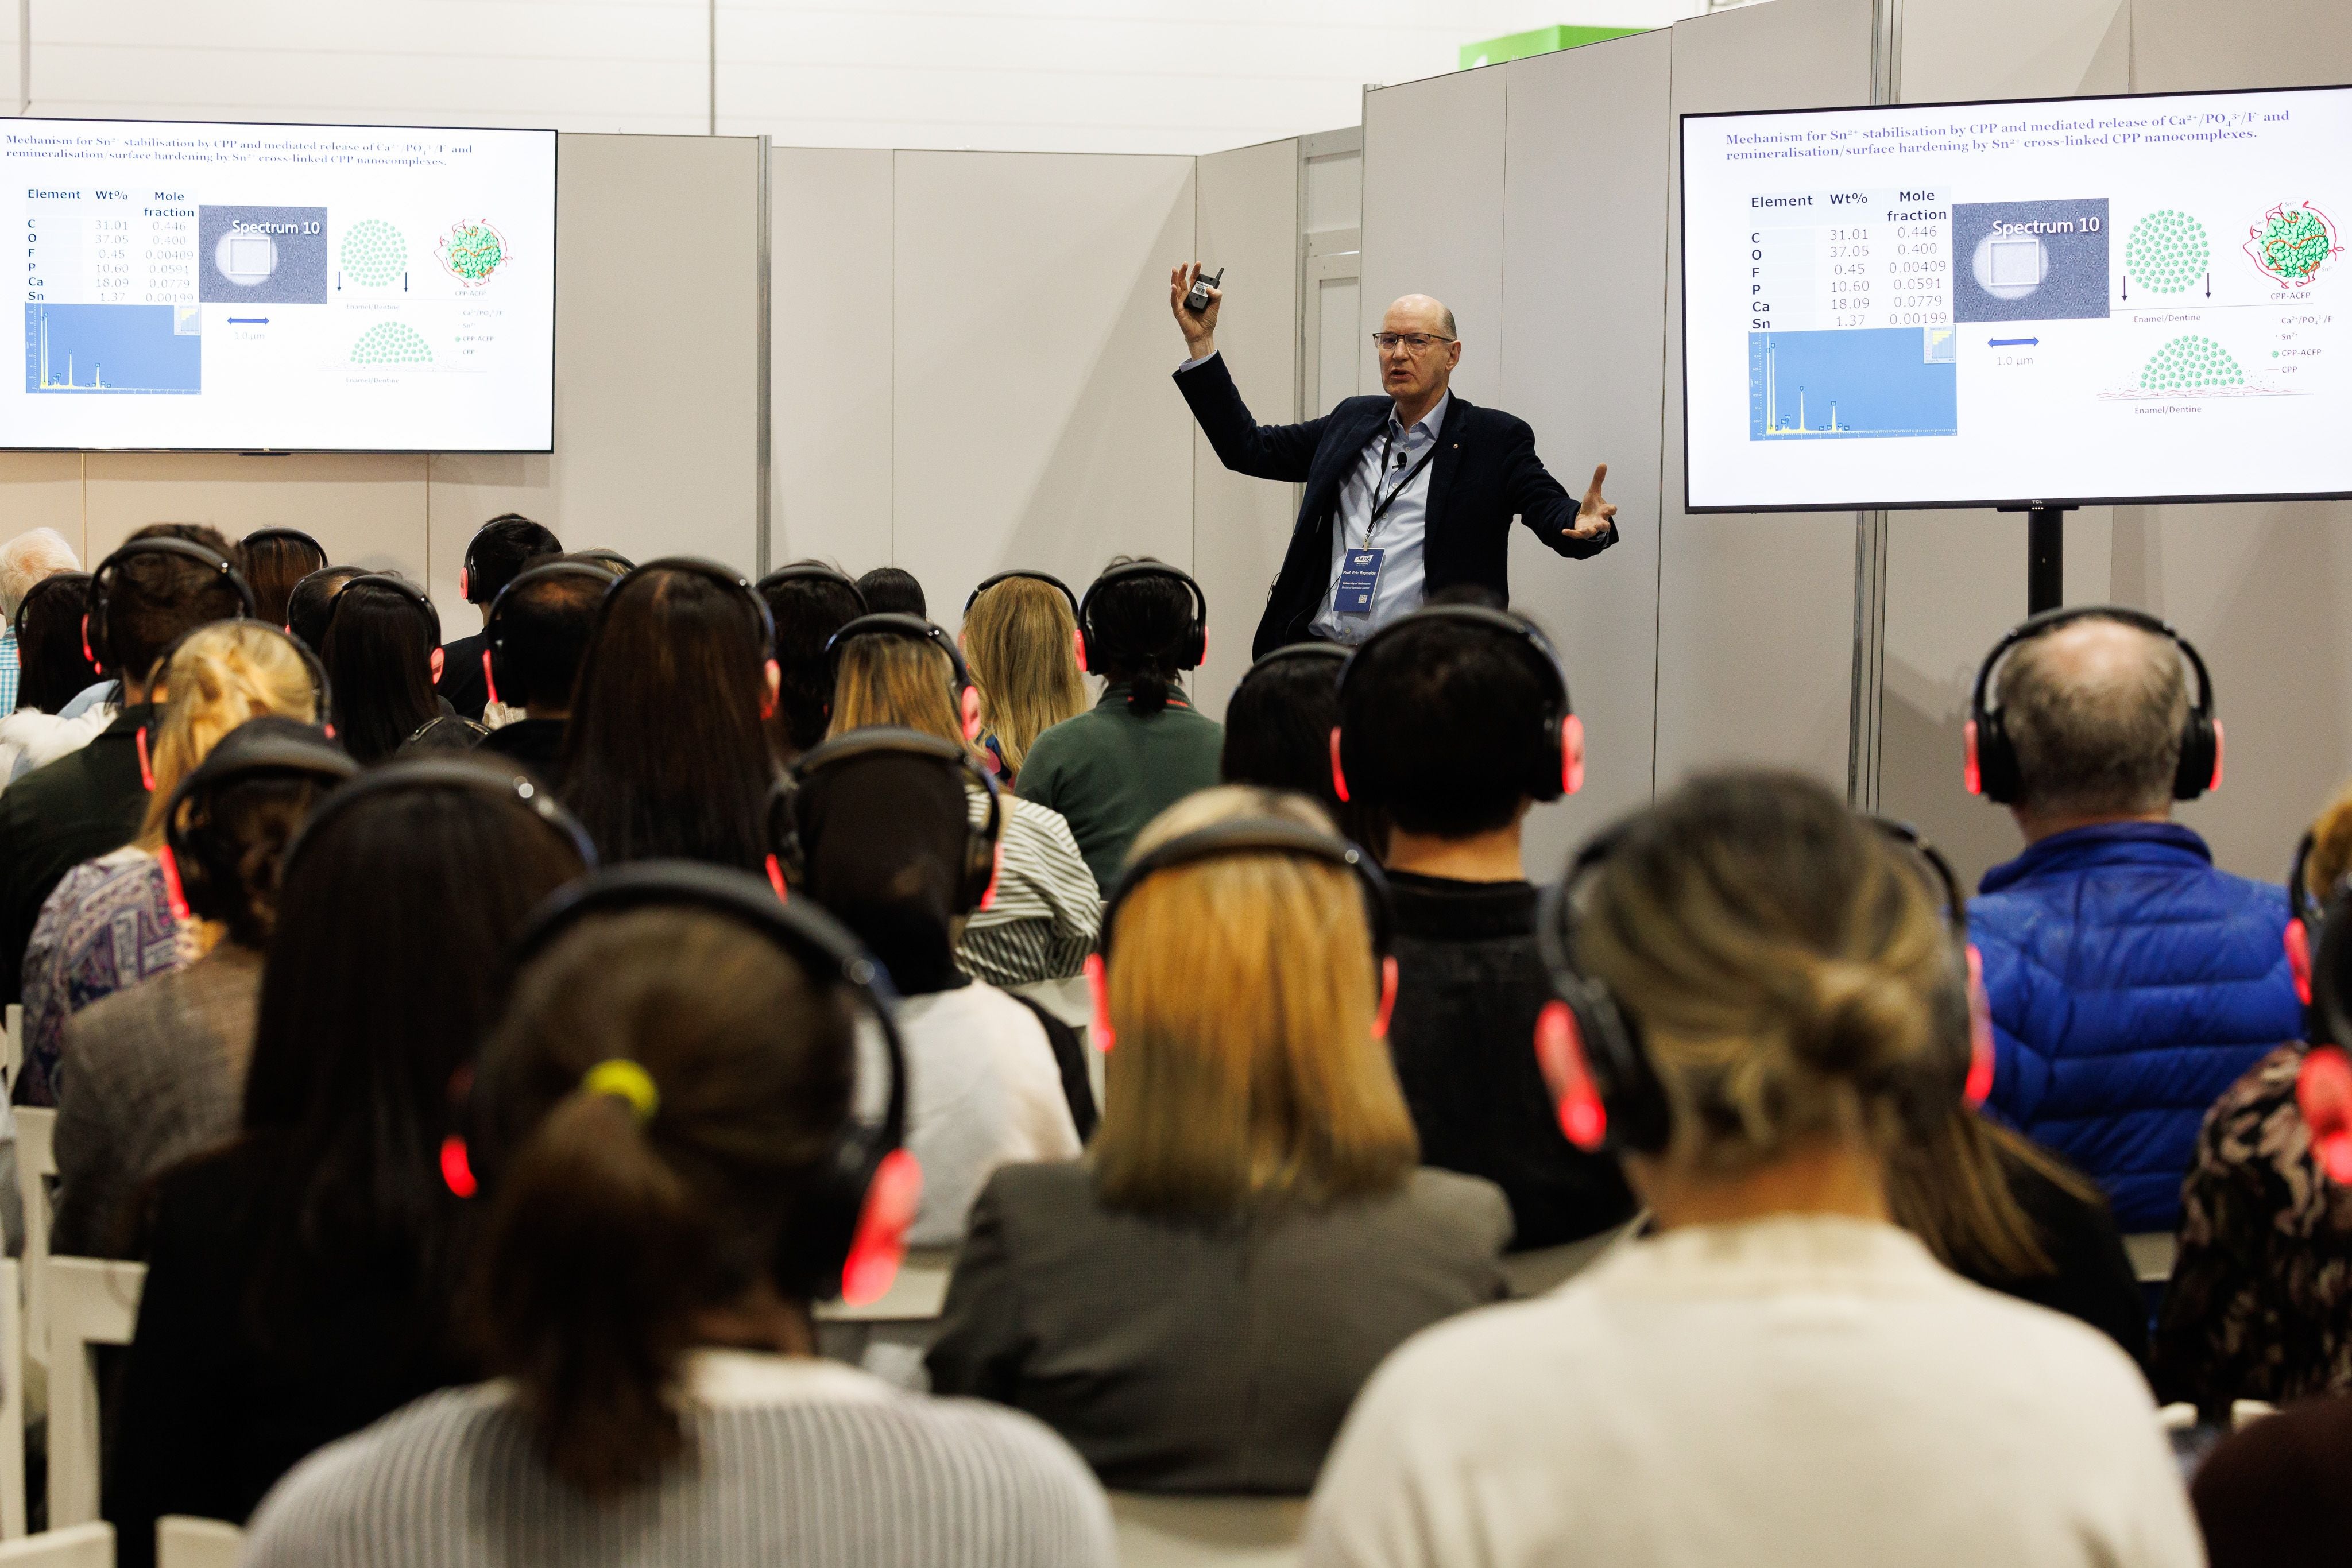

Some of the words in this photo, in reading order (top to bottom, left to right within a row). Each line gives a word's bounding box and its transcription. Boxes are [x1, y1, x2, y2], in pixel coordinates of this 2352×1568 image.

[1726, 132, 1802, 145] Mechanism
[1807, 130, 1827, 141] for
[1862, 124, 1946, 140] stabilisation
[1950, 124, 1966, 137] by
[1970, 123, 1997, 134] CPP
[2001, 121, 2025, 133] and
[2030, 117, 2094, 131] mediated
[2098, 116, 2147, 129] release
[2152, 115, 2166, 126] of
[2264, 110, 2289, 121] and
[6, 135, 72, 144] Mechanism
[76, 136, 93, 145] for
[124, 137, 194, 147] stabilisation
[198, 139, 209, 150] by
[214, 140, 237, 148] CPP
[265, 141, 316, 149] mediated
[363, 143, 375, 151] of
[1726, 144, 1895, 161] remineralisation/surface
[1899, 141, 1969, 155] hardening
[1972, 140, 1987, 153] by
[2024, 134, 2108, 148] cross-linked
[2113, 133, 2140, 144] CPP
[2144, 129, 2257, 145] nanocomplexes.
[6, 148, 150, 160] remineralisation/surface
[154, 152, 213, 162] hardening
[216, 153, 229, 162] by
[259, 154, 327, 163] cross-linked
[331, 156, 354, 164] CPP
[357, 157, 446, 167] nanocomplexes.
[28, 189, 81, 199] Element
[95, 191, 127, 200] Wt%
[154, 192, 184, 201] Mole
[1751, 195, 1813, 208] Element
[1830, 193, 1868, 205] Wt%
[1900, 190, 1935, 202] Mole
[144, 207, 194, 217] fraction
[1887, 210, 1947, 222] fraction
[28, 219, 36, 228] C
[95, 220, 128, 230] 31.01
[153, 221, 186, 231] 0.446
[232, 220, 299, 235] Spectrum
[303, 222, 320, 234] 10
[1993, 219, 2074, 238] Spectrum
[2079, 216, 2099, 233] 10
[28, 234, 36, 243] O
[95, 234, 129, 244] 37.05
[153, 235, 186, 245] 0.400
[1751, 233, 1760, 243] C
[1829, 229, 1869, 241] 31.01
[1898, 226, 1937, 238] 0.446
[29, 249, 35, 257] F
[99, 249, 125, 259] 0.45
[146, 250, 194, 260] 0.00409
[1751, 250, 1762, 261] O
[1830, 246, 1869, 258] 37.05
[1898, 243, 1937, 255] 0.400
[29, 263, 36, 272] P
[96, 264, 129, 273] 10.60
[149, 265, 189, 274] 0.0591
[1753, 268, 1759, 278] F
[1835, 264, 1865, 275] 0.45
[1889, 261, 1947, 273] 0.00409
[28, 278, 44, 287] Ca
[96, 278, 129, 288] 18.09
[149, 279, 190, 288] 0.0779
[1753, 285, 1761, 295] P
[1832, 281, 1869, 292] 10.60
[1894, 278, 1941, 291] 0.0591
[28, 292, 44, 300] Sn
[100, 292, 125, 301] 1.37
[146, 293, 194, 302] 0.00199
[1752, 301, 1770, 312] Ca
[1832, 298, 1869, 310] 18.09
[1894, 295, 1942, 308] 0.0779
[1752, 318, 1771, 329] Sn
[1836, 315, 1866, 327] 1.37
[1890, 312, 1947, 326] 0.00199
[2133, 313, 2201, 323] Enamel/Dentine
[1997, 356, 2012, 365] 1.0
[2134, 405, 2202, 414] Enamel/Dentine
